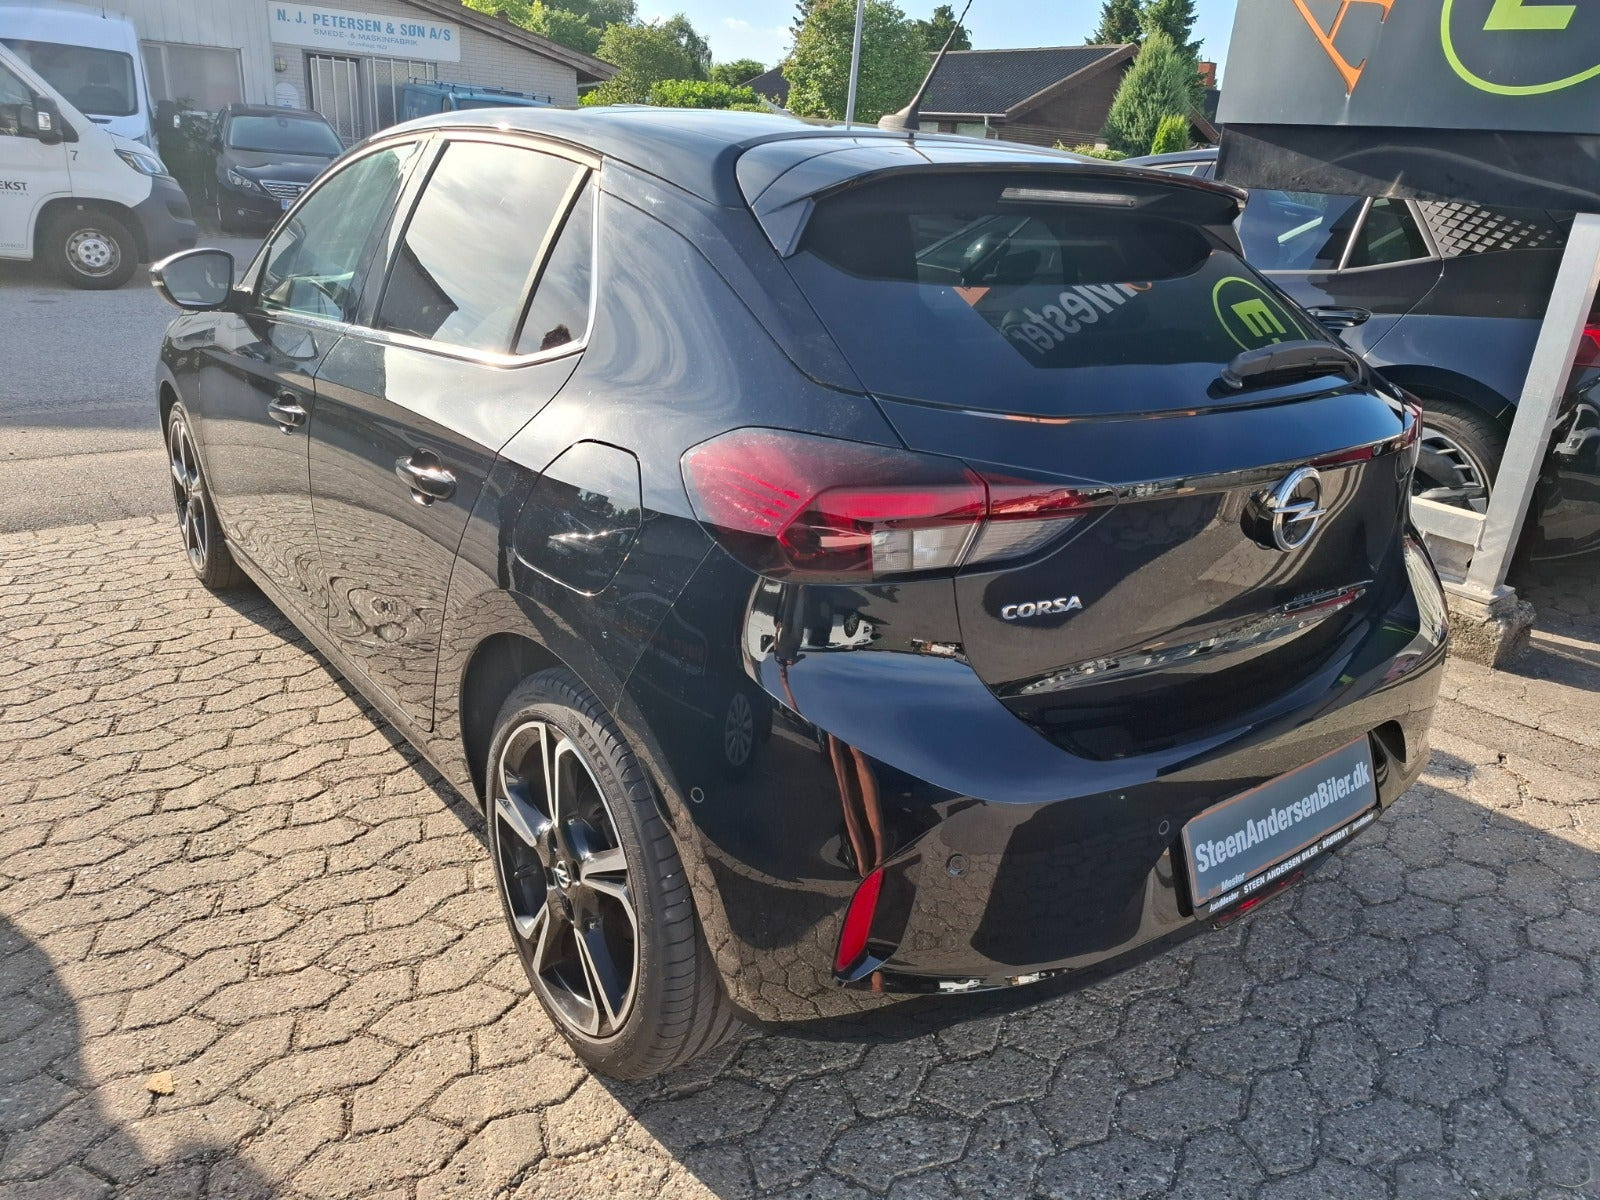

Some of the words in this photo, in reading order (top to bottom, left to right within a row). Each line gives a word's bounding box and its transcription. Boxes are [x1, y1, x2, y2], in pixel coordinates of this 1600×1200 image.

[277, 8, 290, 22] N.
[295, 11, 307, 24] J.
[312, 13, 381, 33] PETERSEN
[385, 23, 395, 35] &
[400, 24, 425, 38] SØN
[429, 27, 451, 41] A/S
[313, 28, 348, 38] SMEDE-
[358, 33, 418, 47] MASKINFABRIK
[70, 150, 79, 161] 7
[1001, 595, 1083, 620] CORSA
[1195, 761, 1371, 873] SteenAndersenBiler.dk
[1243, 875, 1265, 894] STEEN
[1266, 855, 1301, 881] ANDERSEN
[1301, 845, 1319, 862] BILER
